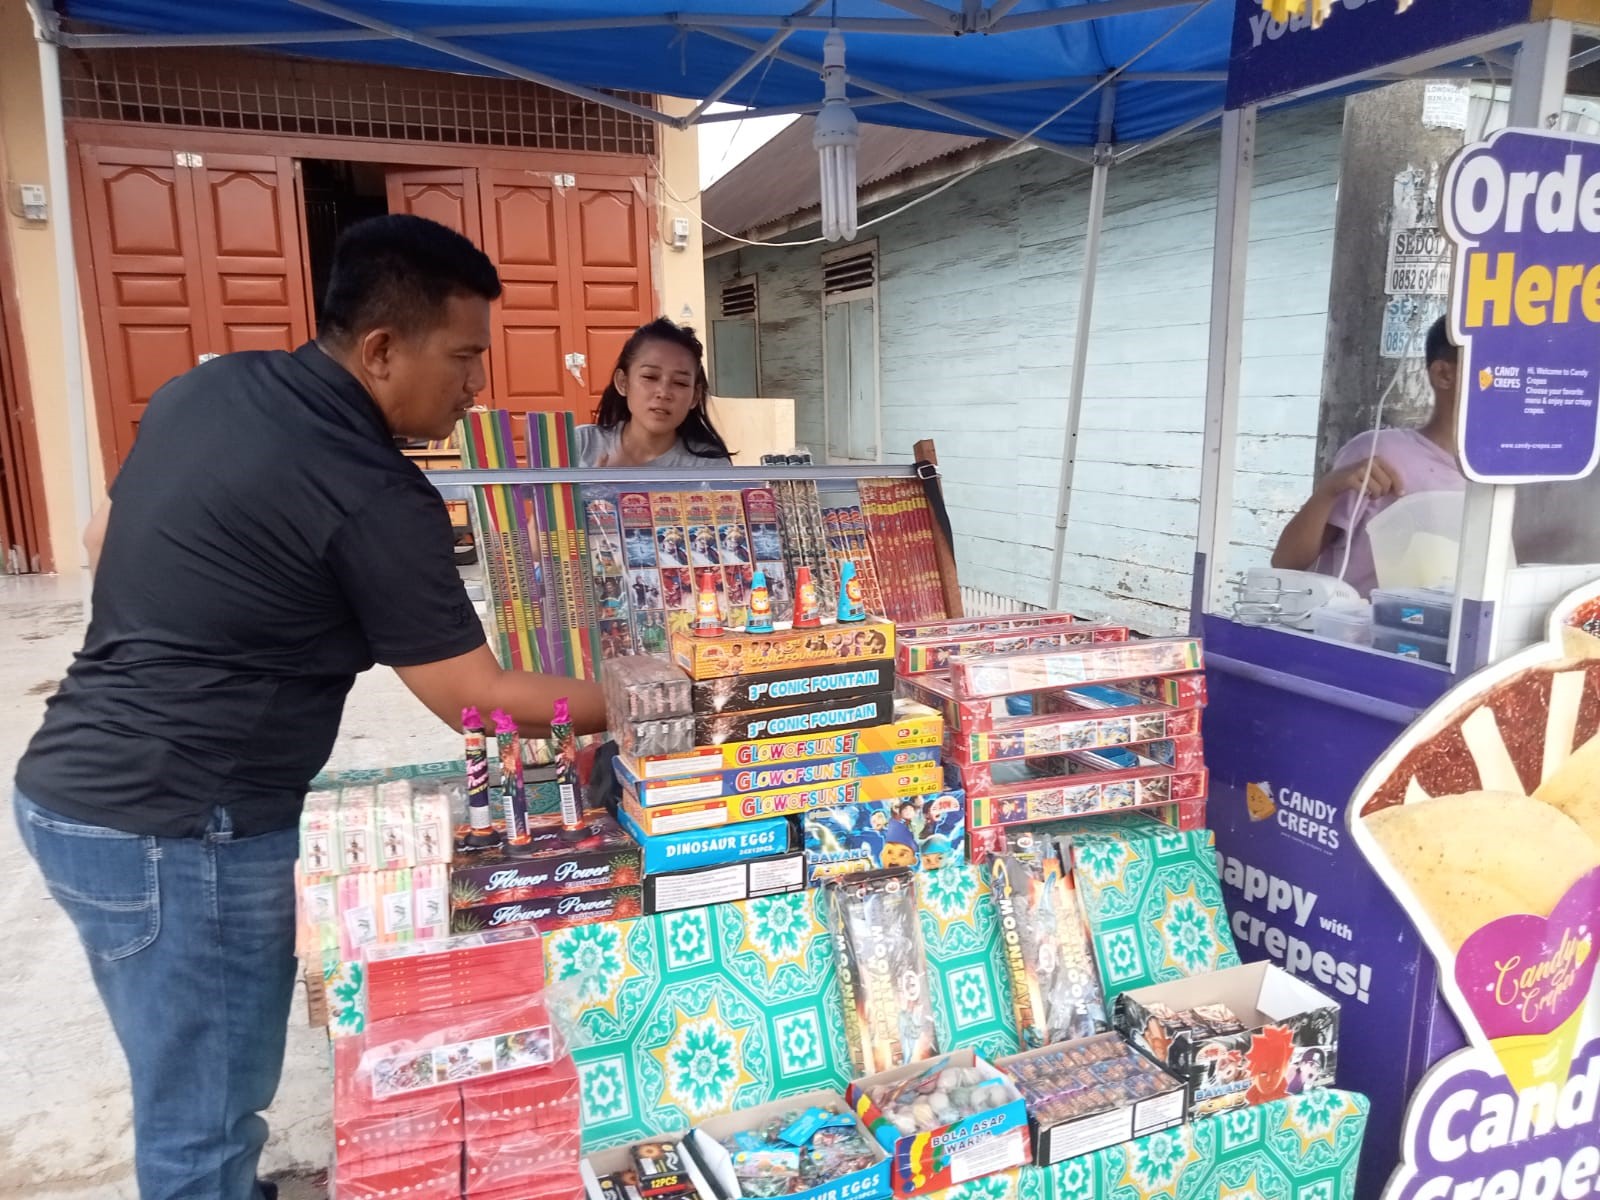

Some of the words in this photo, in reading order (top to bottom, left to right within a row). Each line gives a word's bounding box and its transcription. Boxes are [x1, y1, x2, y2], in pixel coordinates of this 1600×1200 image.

[1249, 8, 1318, 47] You
[1393, 269, 1416, 290] 0852
[1493, 377, 1521, 389] CREPES
[1494, 366, 1520, 377] CANDY
[1526, 377, 1548, 386] Crepes
[1536, 367, 1562, 376] Welcome
[1563, 368, 1570, 376] to
[1570, 368, 1589, 378] Candy
[1525, 386, 1548, 395] Choose
[1549, 388, 1562, 397] your
[1542, 397, 1548, 405] &
[1548, 398, 1564, 407] enjoy
[1574, 398, 1592, 407] crispy
[750, 653, 785, 666] CONIC
[785, 650, 838, 662] FOUNTAIN
[769, 678, 810, 698] CONIC
[811, 670, 879, 692] FOUNTAIN
[767, 714, 809, 735] CONIC
[810, 702, 877, 729] FOUNTAIN
[1279, 788, 1337, 824] CANDY
[1277, 809, 1339, 849] CREPES
[665, 837, 736, 857] DINOSAUR
[741, 831, 775, 847] EGGS
[811, 849, 870, 863] BAWANG
[485, 869, 548, 891] Flower
[554, 861, 610, 882] Power
[488, 904, 551, 925] Flower
[557, 896, 613, 915] Power
[1319, 916, 1353, 941] with
[1232, 910, 1372, 1005] crepes!
[1494, 927, 1577, 1006] Candy
[932, 1128, 967, 1148] BOLA
[971, 1114, 1006, 1135] ASAP
[651, 1176, 678, 1188] 12PCS
[841, 1174, 880, 1198] EGGS
